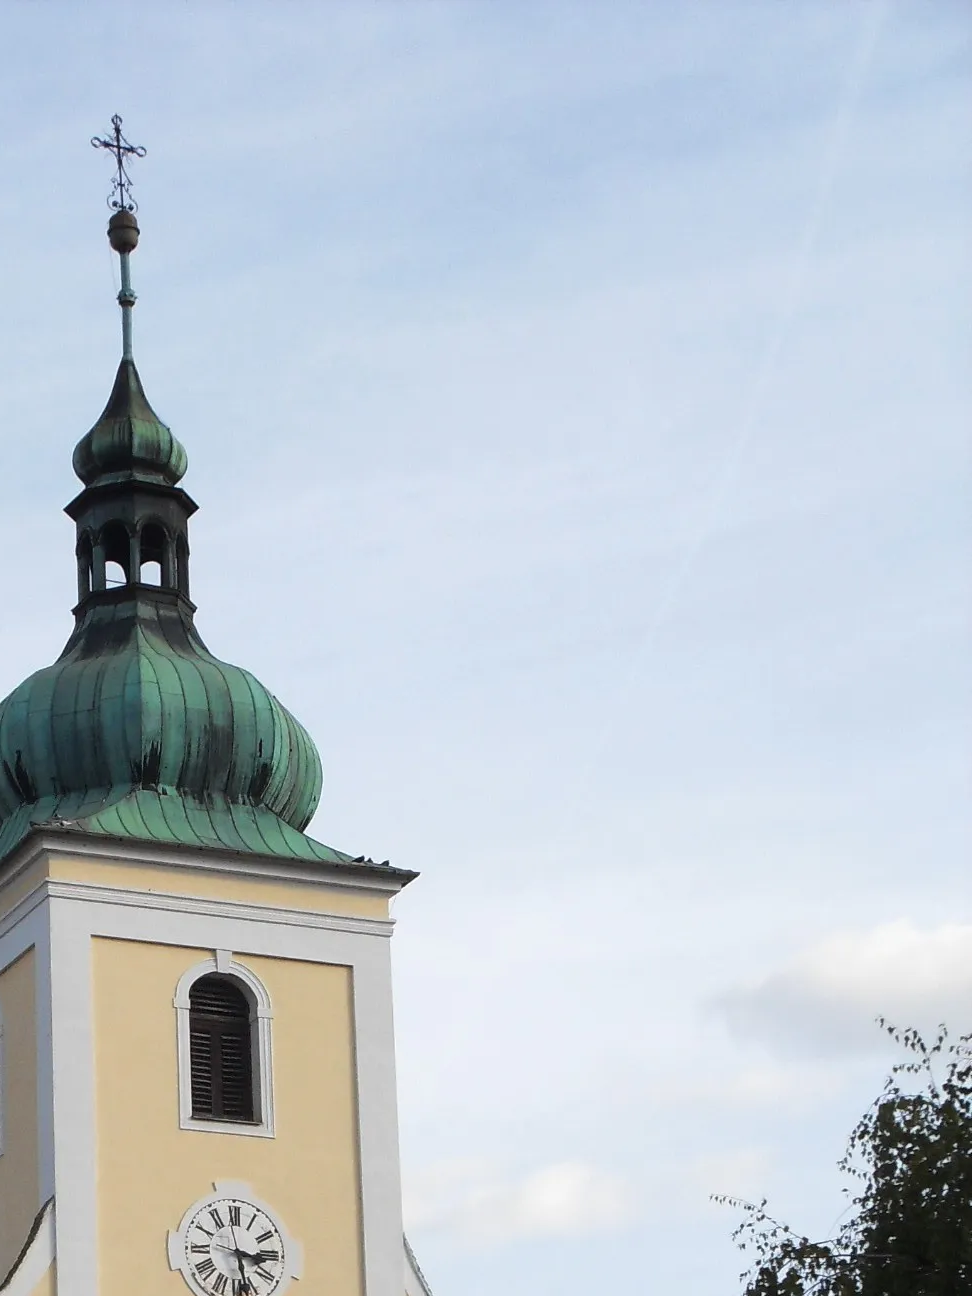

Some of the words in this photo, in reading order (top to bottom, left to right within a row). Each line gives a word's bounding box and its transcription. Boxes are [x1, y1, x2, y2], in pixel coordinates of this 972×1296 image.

[208, 1208, 225, 1230] XI
[228, 1205, 241, 1227] XII
[246, 1213, 258, 1231] I
[195, 1221, 215, 1240] X
[255, 1230, 274, 1244] II
[259, 1249, 279, 1261] III
[194, 1257, 217, 1282] VIII
